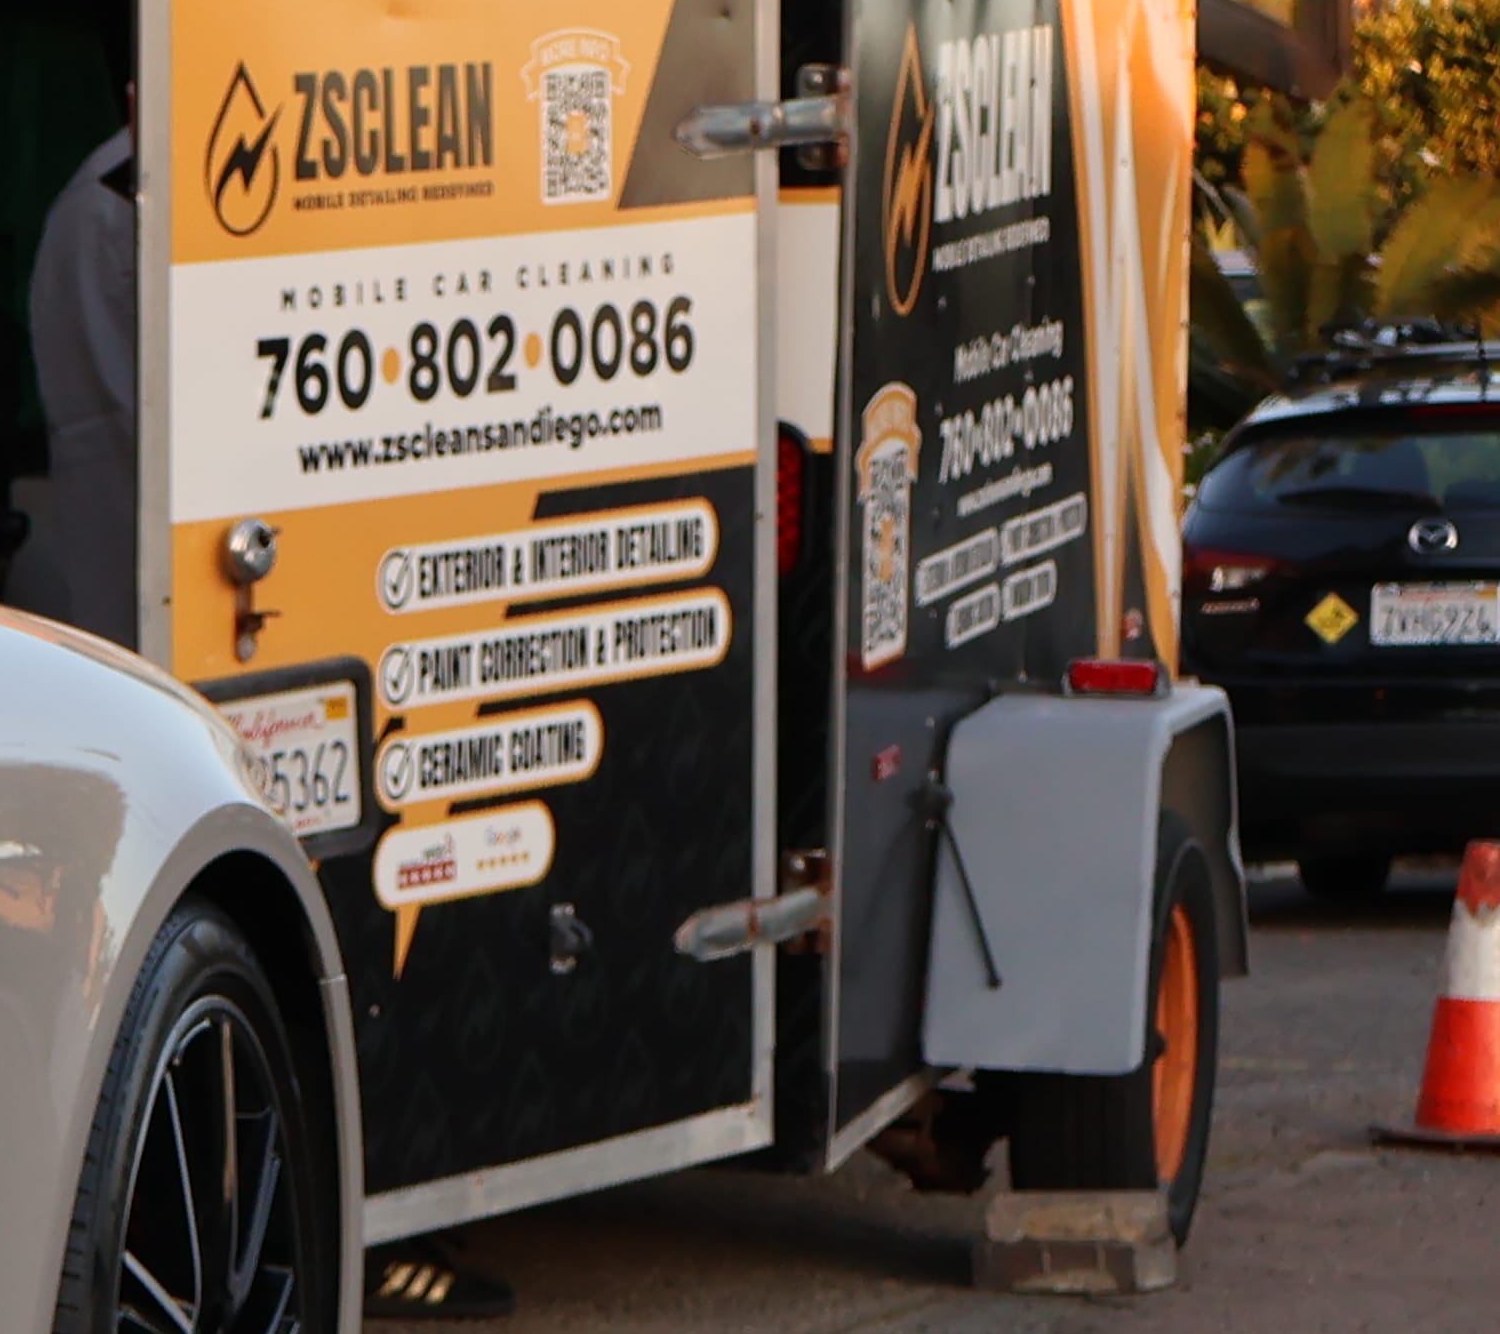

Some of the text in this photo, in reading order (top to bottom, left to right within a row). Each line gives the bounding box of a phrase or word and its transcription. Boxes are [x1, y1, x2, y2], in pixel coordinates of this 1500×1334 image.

[293, 59, 494, 182] ZSCLEAN
[280, 253, 675, 310] MOBILE CAR CLEANING
[299, 404, 663, 474] www.zscleansandiego.com
[419, 544, 505, 599] EXTERIOR
[532, 530, 608, 583] INTERIOR
[615, 517, 703, 569] DETAILING
[420, 643, 472, 693] PAINT
[480, 625, 589, 684] CORRECTION
[614, 606, 716, 658] PROTECTION
[420, 719, 585, 788] CERAMIC COATING
